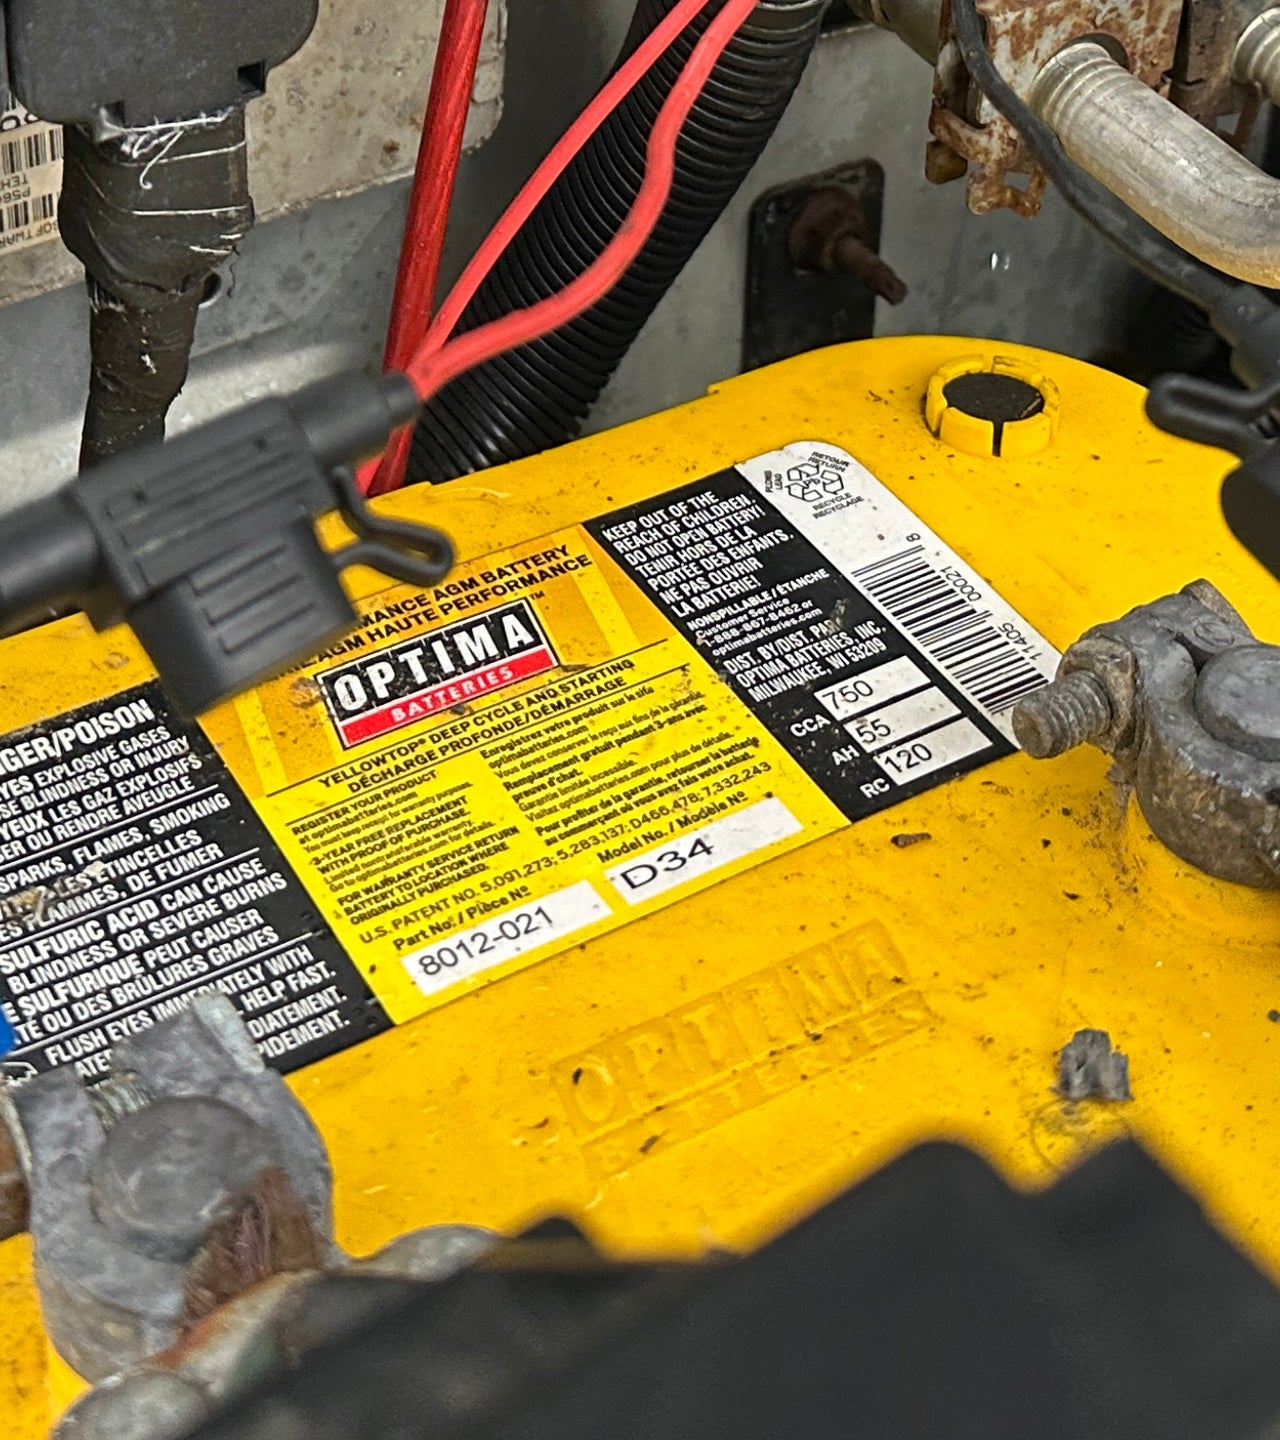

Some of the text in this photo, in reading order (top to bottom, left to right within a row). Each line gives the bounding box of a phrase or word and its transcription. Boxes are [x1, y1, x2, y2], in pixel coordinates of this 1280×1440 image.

[601, 490, 719, 542] KEEP OUT OF THE
[812, 492, 852, 511] RECYCLE
[812, 495, 865, 519] RECYCLAGE
[612, 527, 663, 554] REACH
[660, 520, 680, 535] OF
[623, 504, 766, 566] DO NOT OPEN BATTERY!
[634, 525, 758, 578] TENIR HORS DE LA
[646, 529, 794, 591] PORTÉE DES ENFANTS.
[365, 607, 439, 642] HAUTE
[438, 554, 592, 616] PERFORMANCE
[433, 544, 569, 602] AGM BATTERY
[659, 556, 763, 604] NE PAS OUVRIR
[670, 574, 761, 617] LA BATTERIE!
[903, 531, 1042, 661] 11405 00021 8
[695, 597, 790, 642] Customer Service
[699, 603, 802, 647] 1-888-867-8462
[712, 608, 823, 656] optimabatteries.com
[333, 613, 534, 711] OPTIMA
[722, 651, 761, 674] DIST.
[756, 630, 814, 660] BY/DIST.
[735, 620, 886, 688] OPTIMA BATTERIES, INC.
[747, 637, 887, 702] MILWAUKEE, WI 53209
[390, 666, 513, 722] BATTERIES
[428, 721, 470, 744] DEEP
[472, 700, 525, 726] CYCLE
[525, 688, 560, 707] AND
[557, 659, 635, 693] STARTING
[821, 680, 874, 710] 750
[33, 744, 120, 787] EXPLOSIVE
[118, 725, 171, 755] GASES
[347, 676, 627, 793] DÉCHARGE PROFONDE/DÉMARRAGE
[790, 714, 831, 737] CCA
[831, 744, 860, 766] AH
[855, 718, 891, 744] 55
[19, 767, 110, 811] BLINDNESS
[109, 758, 136, 778] OR
[133, 735, 190, 768] INJURY
[47, 799, 82, 823] LES
[81, 786, 118, 810] GAZ
[115, 752, 202, 797] EXPLOSIFS
[859, 777, 890, 798] RC
[884, 743, 932, 773] 120
[25, 829, 53, 850] OU
[52, 804, 122, 841] RENDRE
[122, 775, 195, 815] AVEUGLE
[71, 826, 151, 865] FLAMES,
[149, 792, 231, 835] SMOKING
[291, 769, 437, 836] REGISTER YOUR PRODUCT
[596, 836, 643, 863] Model
[675, 802, 728, 828] Modèle
[22, 883, 127, 931] FLAMMES,
[125, 869, 156, 892] DE
[154, 843, 224, 881] FUMER
[336, 825, 520, 906] FOR WARRANTY SERVICE RETURN
[620, 837, 713, 889] D34
[106, 899, 160, 934] ACID
[160, 883, 203, 911] CAN
[202, 857, 267, 894] CAUSE
[391, 897, 450, 930] PATENT
[392, 932, 421, 951] Part
[465, 896, 509, 919] Pièce
[7, 872, 287, 994] BLINDNESS OR SEVERE BURNS
[418, 906, 553, 976] 8012-021
[17, 908, 264, 1020] SULFURIQUE PEUT CAUSER
[41, 1007, 73, 1032] OU
[71, 993, 112, 1021] DES
[110, 954, 209, 1005] BRÛLURES
[207, 925, 279, 966] GRAVES
[239, 960, 336, 1011] HELP FAST.
[44, 1028, 108, 1066] FLUSH
[105, 1009, 154, 1042] EYES
[264, 944, 314, 976] WITH
